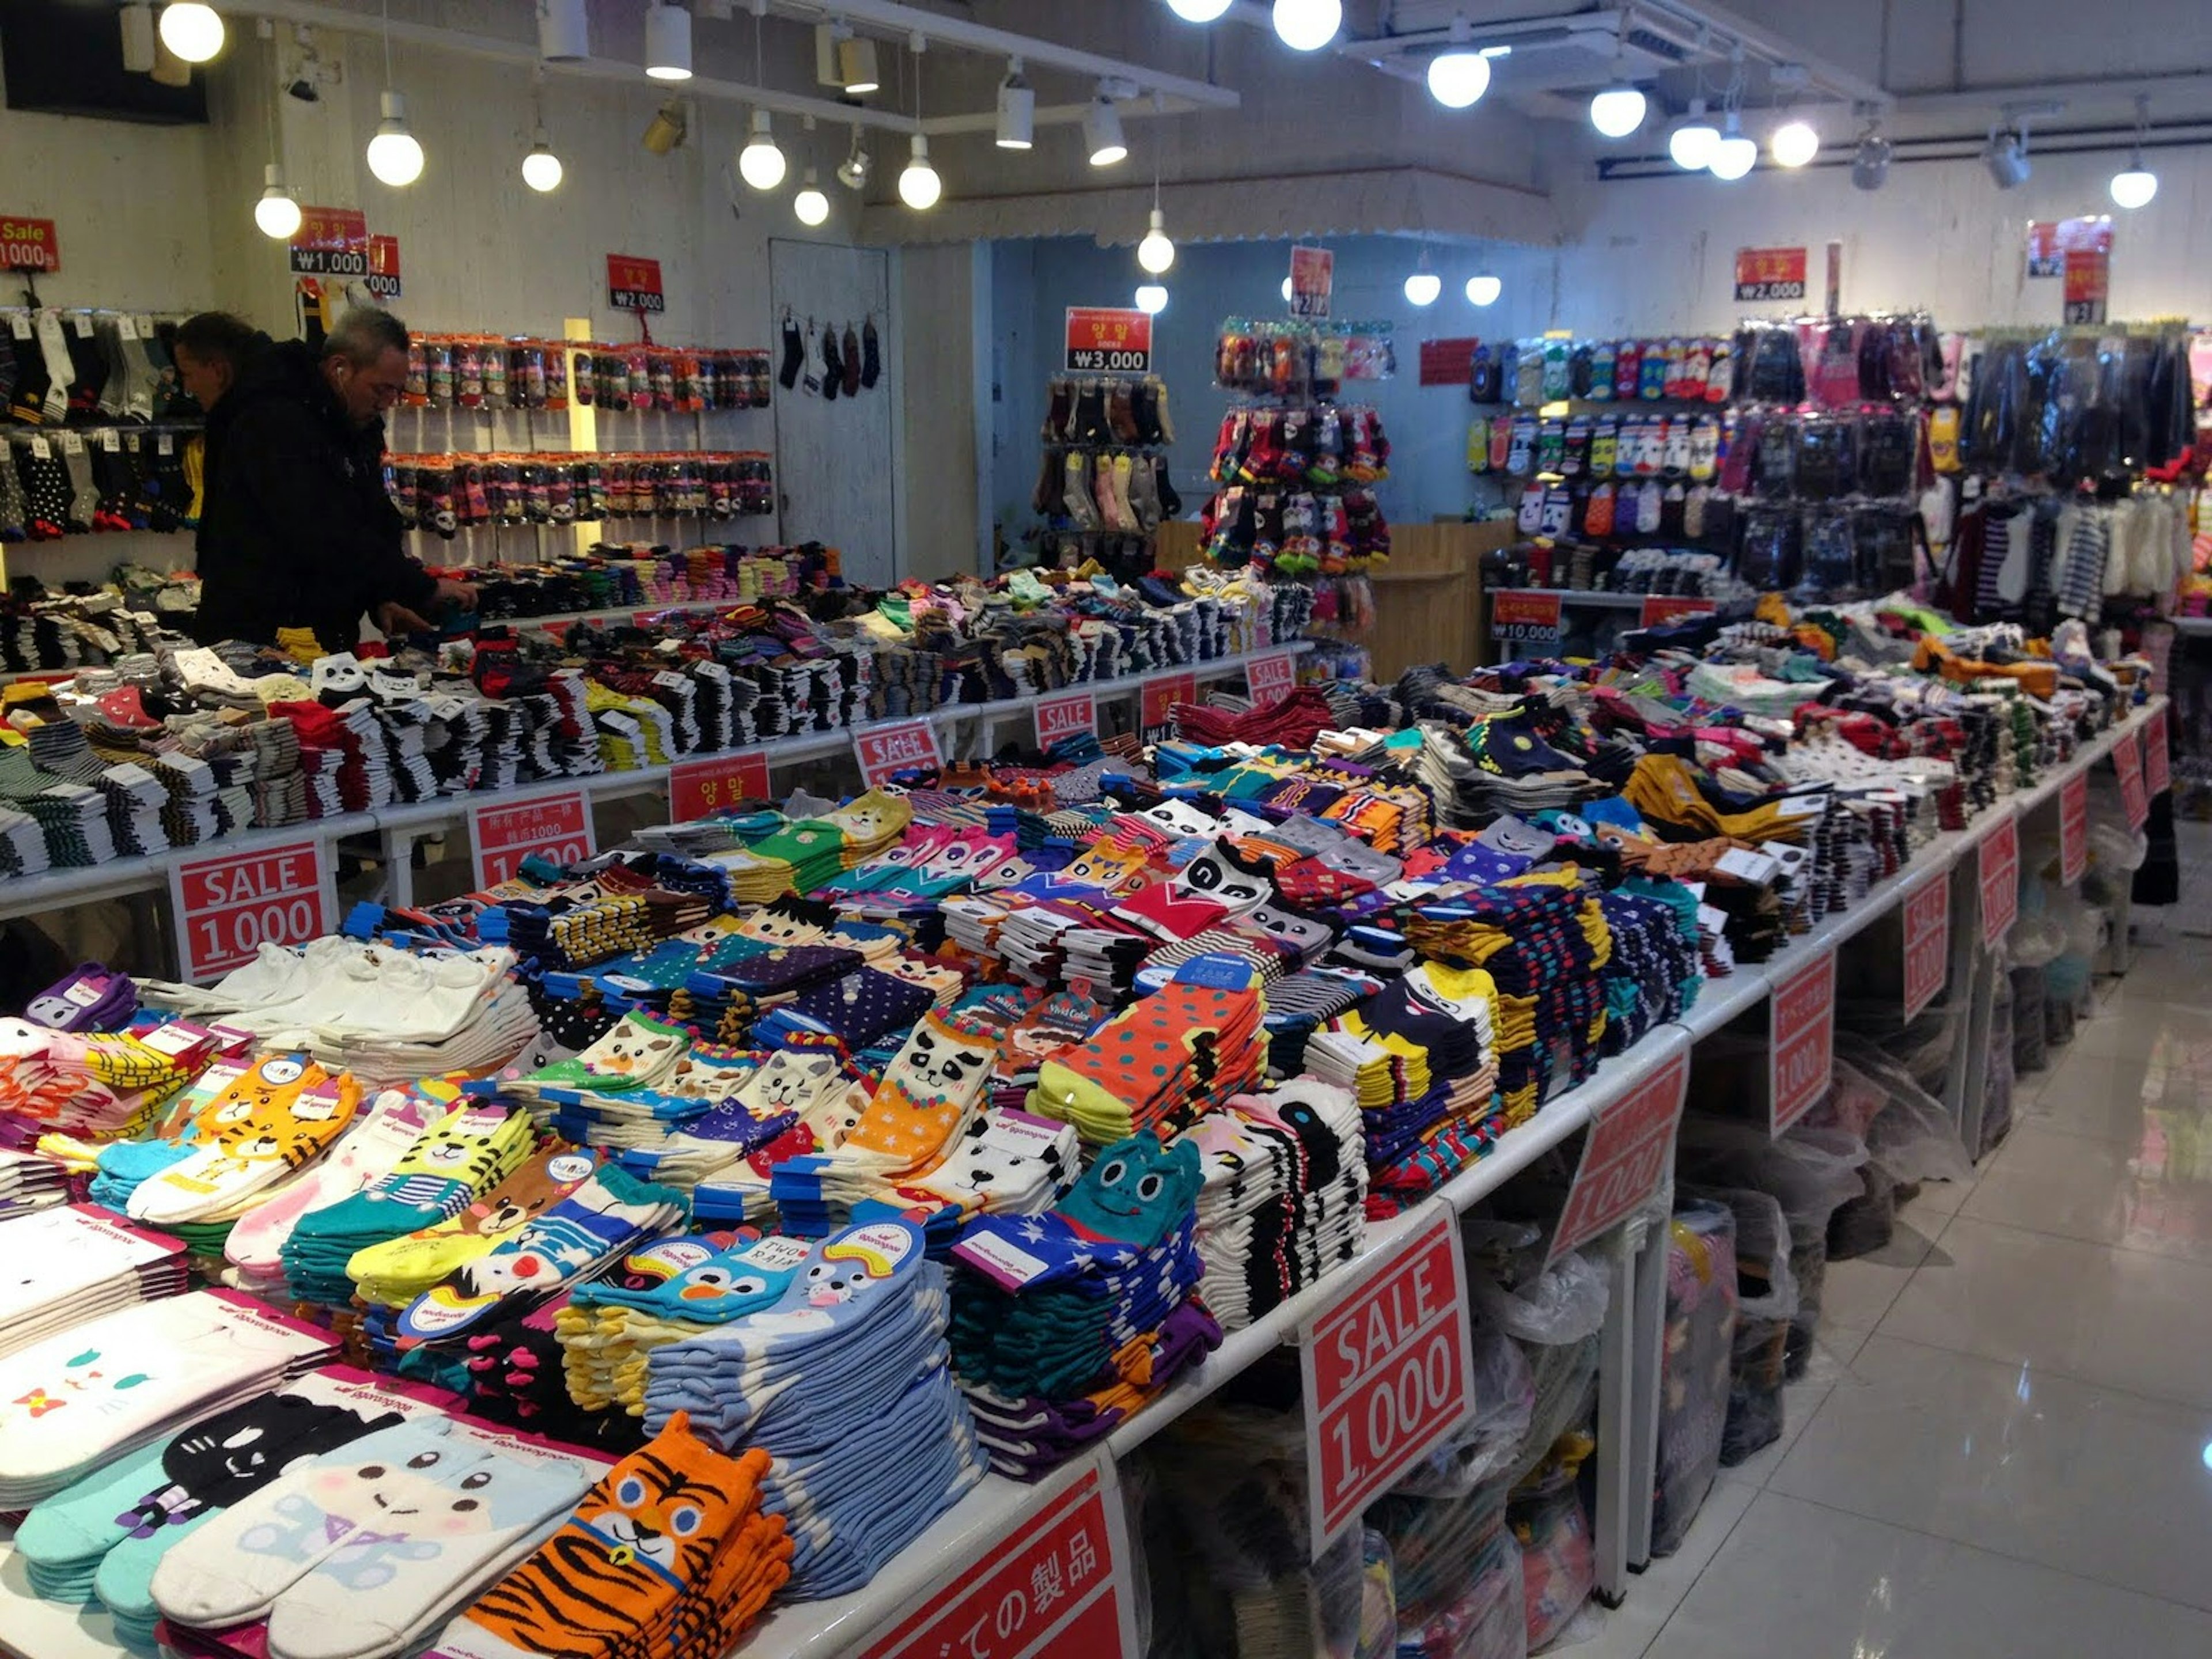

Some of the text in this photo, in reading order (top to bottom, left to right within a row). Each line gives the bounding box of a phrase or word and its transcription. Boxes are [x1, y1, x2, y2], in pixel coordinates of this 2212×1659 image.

[2, 221, 44, 241] Sale
[297, 252, 363, 274] ₩1,000
[615, 291, 661, 309] ₩2000
[1074, 350, 1144, 370] ₩3,000
[1256, 662, 1286, 685] SALE
[1047, 704, 1085, 730] SALE
[872, 732, 924, 764] SALE
[203, 857, 298, 908] SALE
[199, 900, 314, 962] 1,000
[765, 1241, 798, 1256] TWO
[1336, 1259, 1437, 1391] SALE
[1332, 1334, 1453, 1498] 1,000
[940, 1527, 1097, 1659] ての製品
